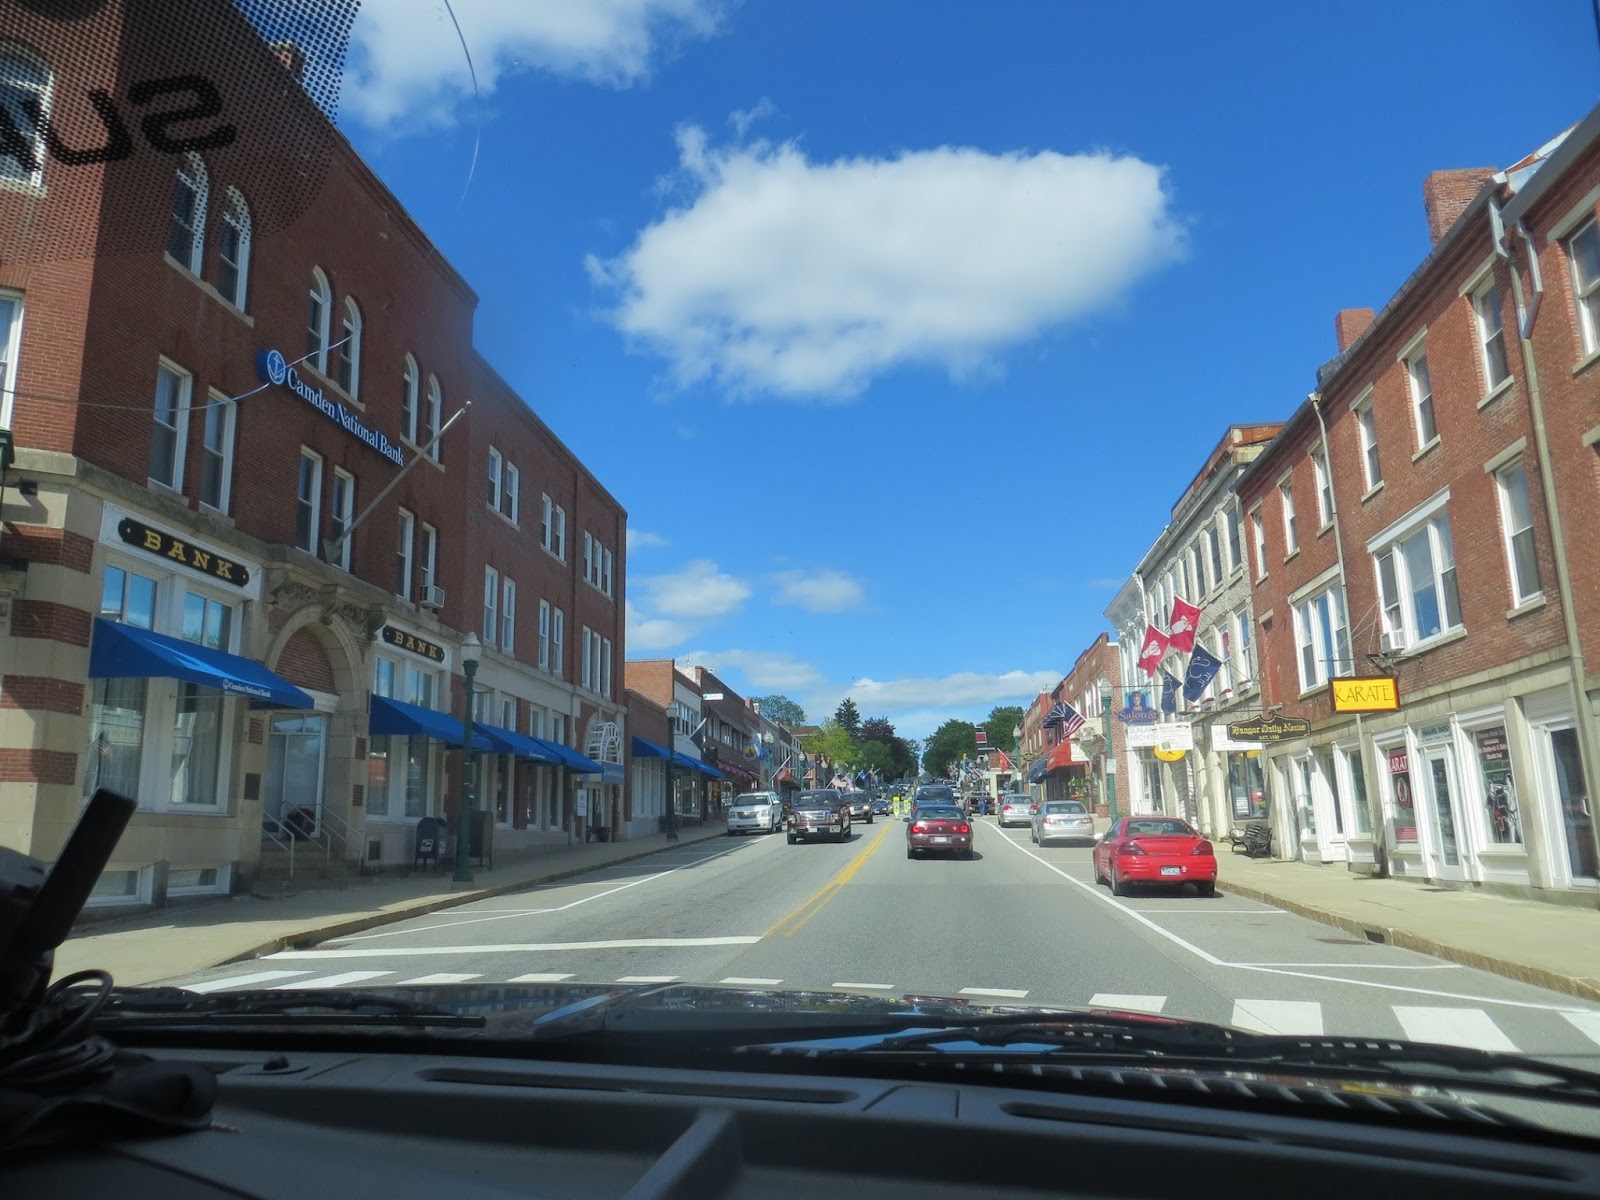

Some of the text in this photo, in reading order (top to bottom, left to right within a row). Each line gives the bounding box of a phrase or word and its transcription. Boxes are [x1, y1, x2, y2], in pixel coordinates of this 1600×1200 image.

[287, 367, 404, 467] Camden National Bank
[143, 529, 233, 579] BANK
[394, 631, 438, 658] BANK
[245, 685, 261, 696] National
[1335, 685, 1394, 703] KARATE
[1119, 710, 1158, 721] Salon &
[1231, 722, 1306, 735] Bangor Daily News
